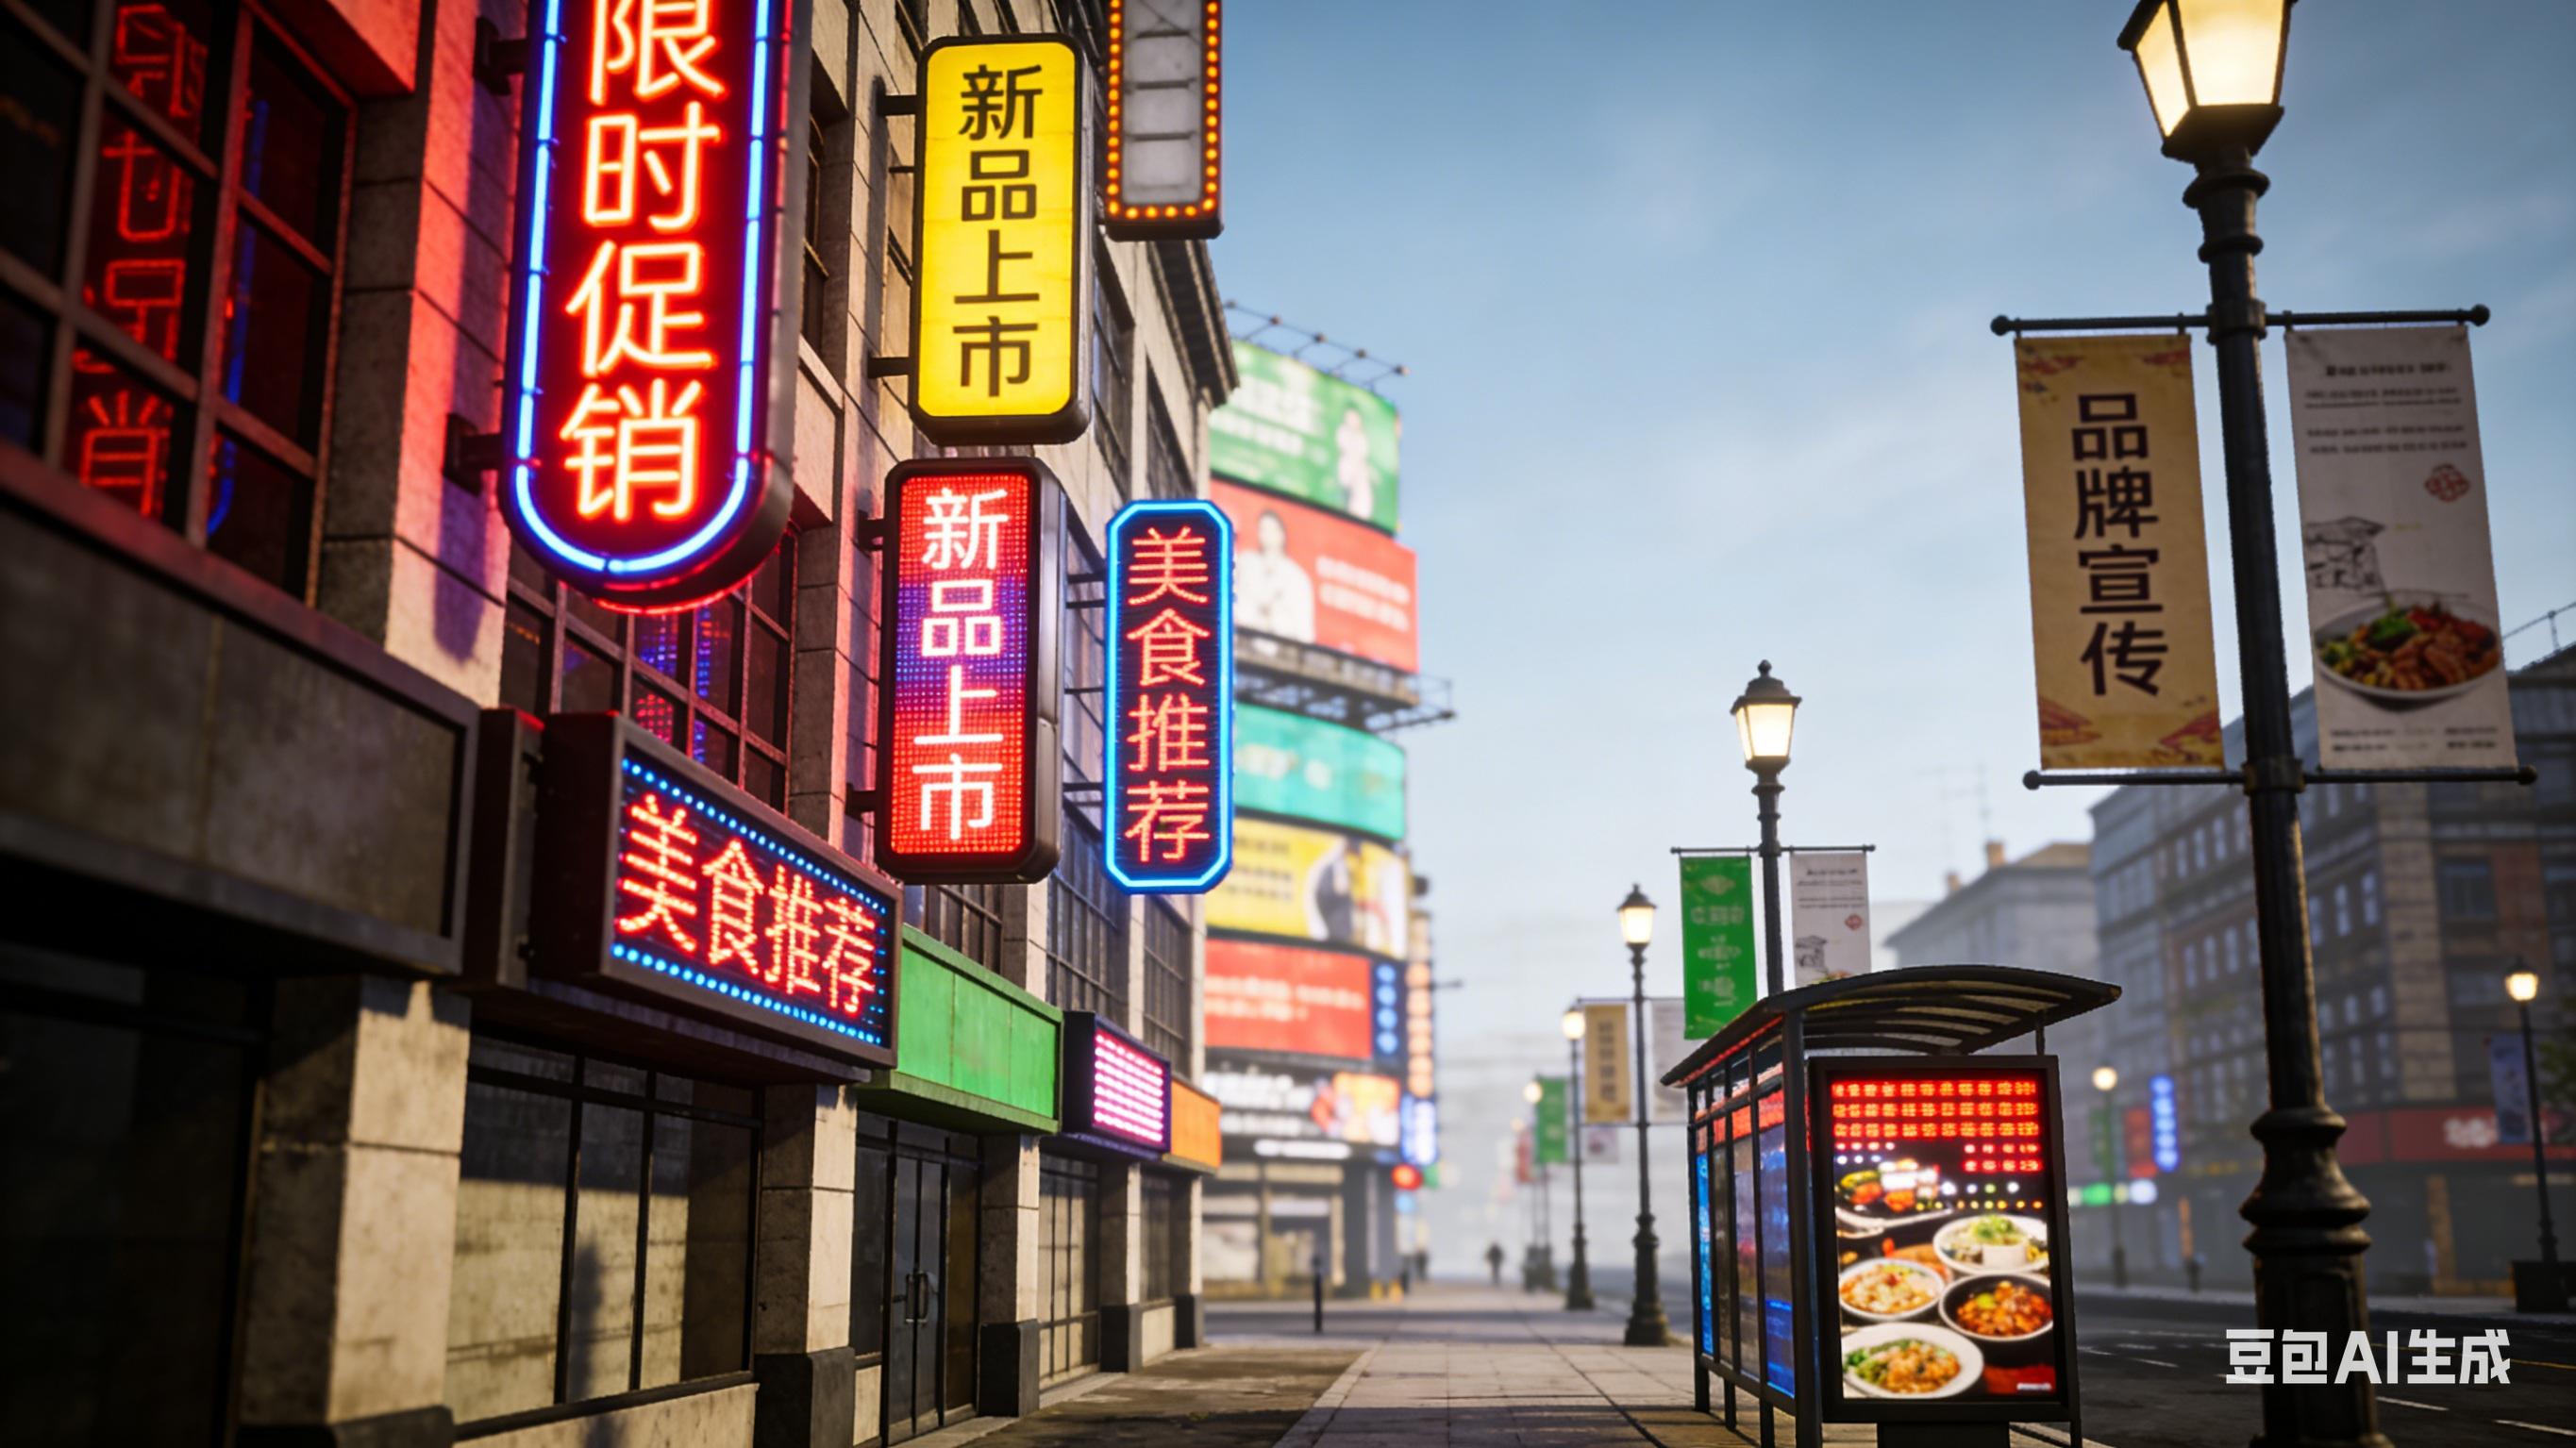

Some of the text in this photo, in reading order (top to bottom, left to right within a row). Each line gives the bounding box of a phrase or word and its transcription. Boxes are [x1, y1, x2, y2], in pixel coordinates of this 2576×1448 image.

[560, 0, 726, 521] 限时促销
[953, 63, 1043, 398] 新品上市
[912, 488, 1009, 841] 新品上市
[1126, 526, 1211, 863] 美食推荐
[2071, 392, 2168, 697] 品牌宣传
[614, 793, 876, 1016] 美食推荐
